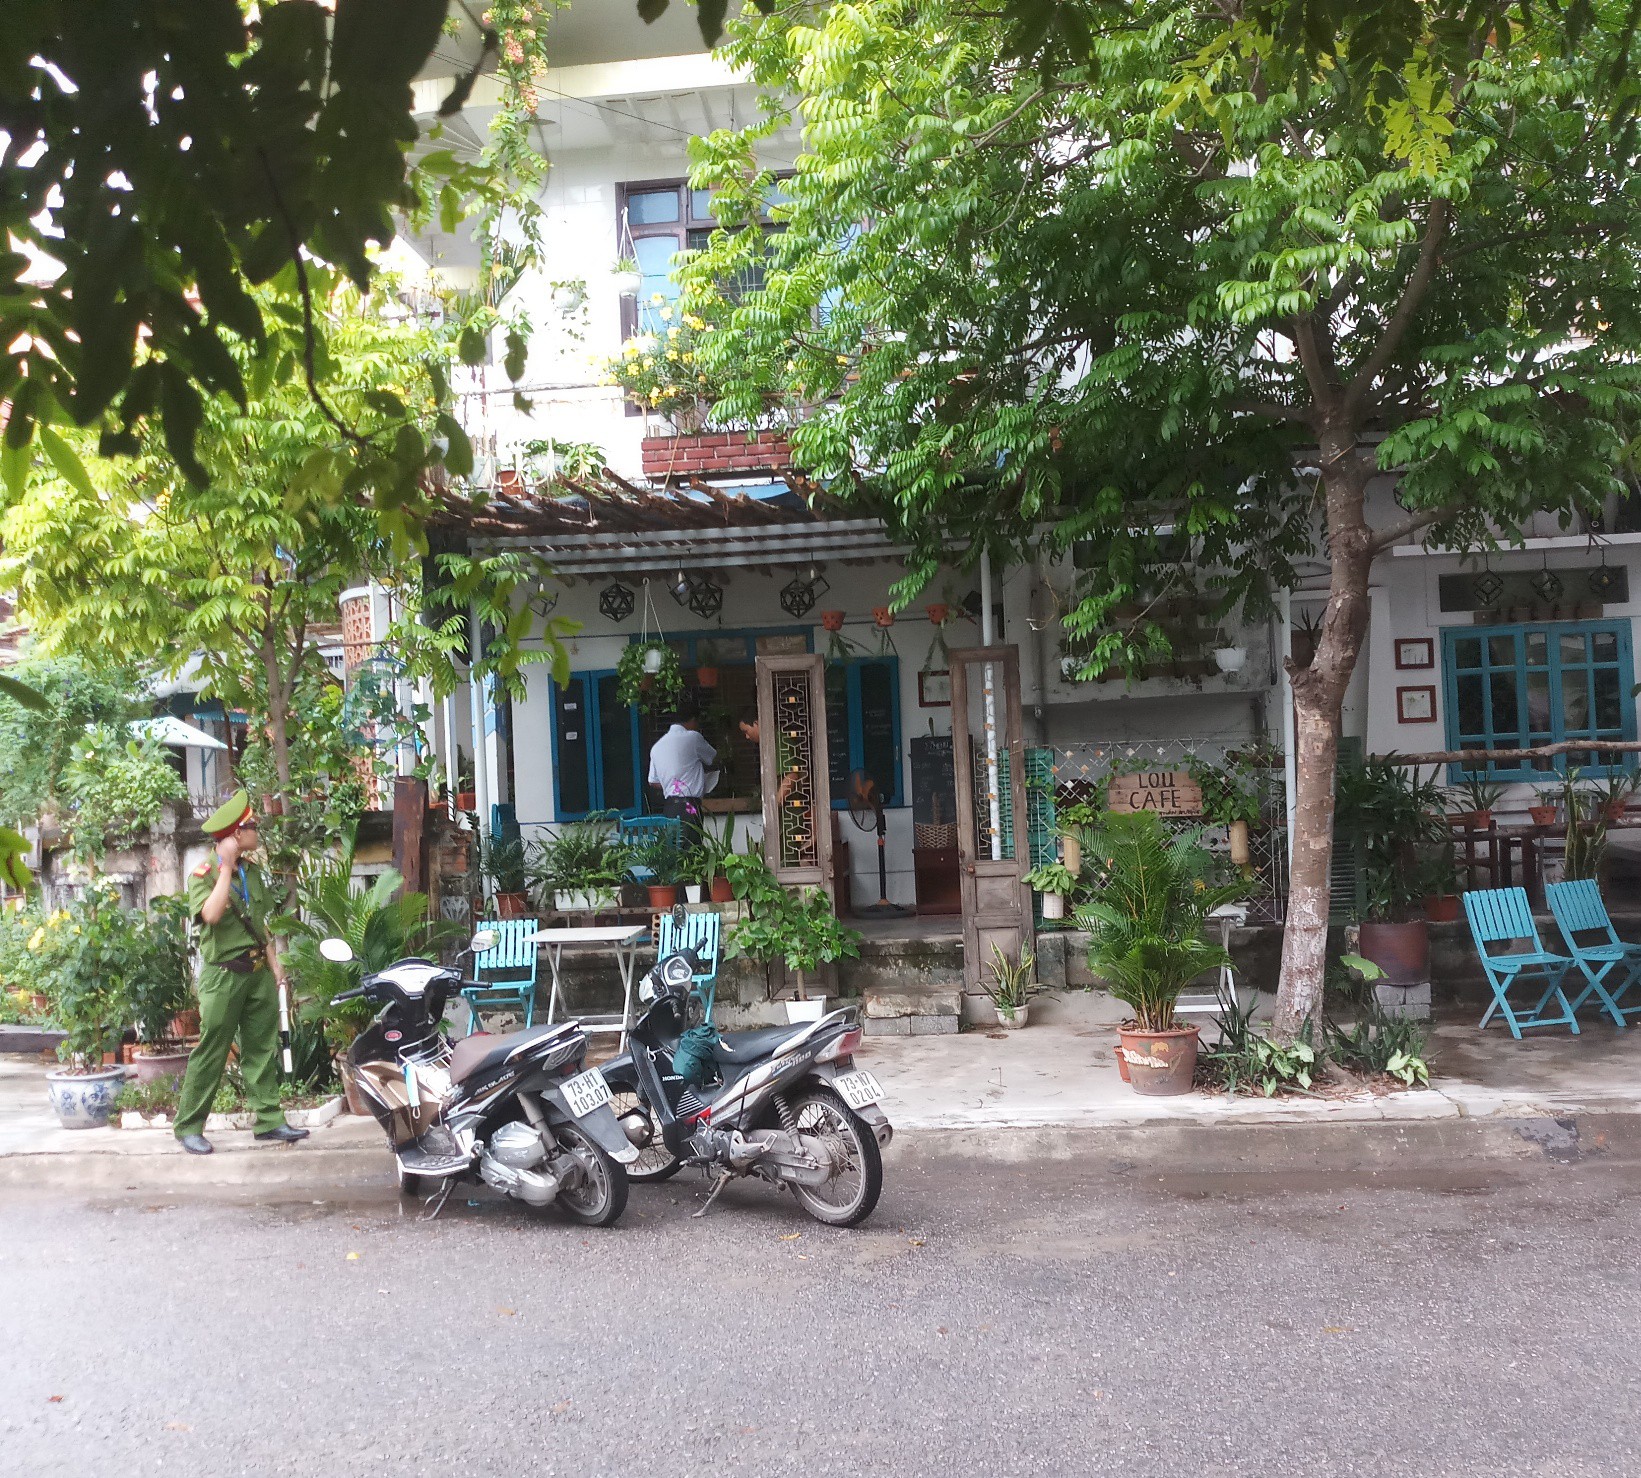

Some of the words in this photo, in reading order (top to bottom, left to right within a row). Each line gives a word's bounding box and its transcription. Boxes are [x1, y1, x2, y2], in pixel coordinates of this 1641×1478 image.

[1138, 772, 1176, 788] LOU
[1129, 789, 1181, 809] CAFE
[573, 1085, 609, 1114] 103.07
[850, 1086, 881, 1105] 0204
